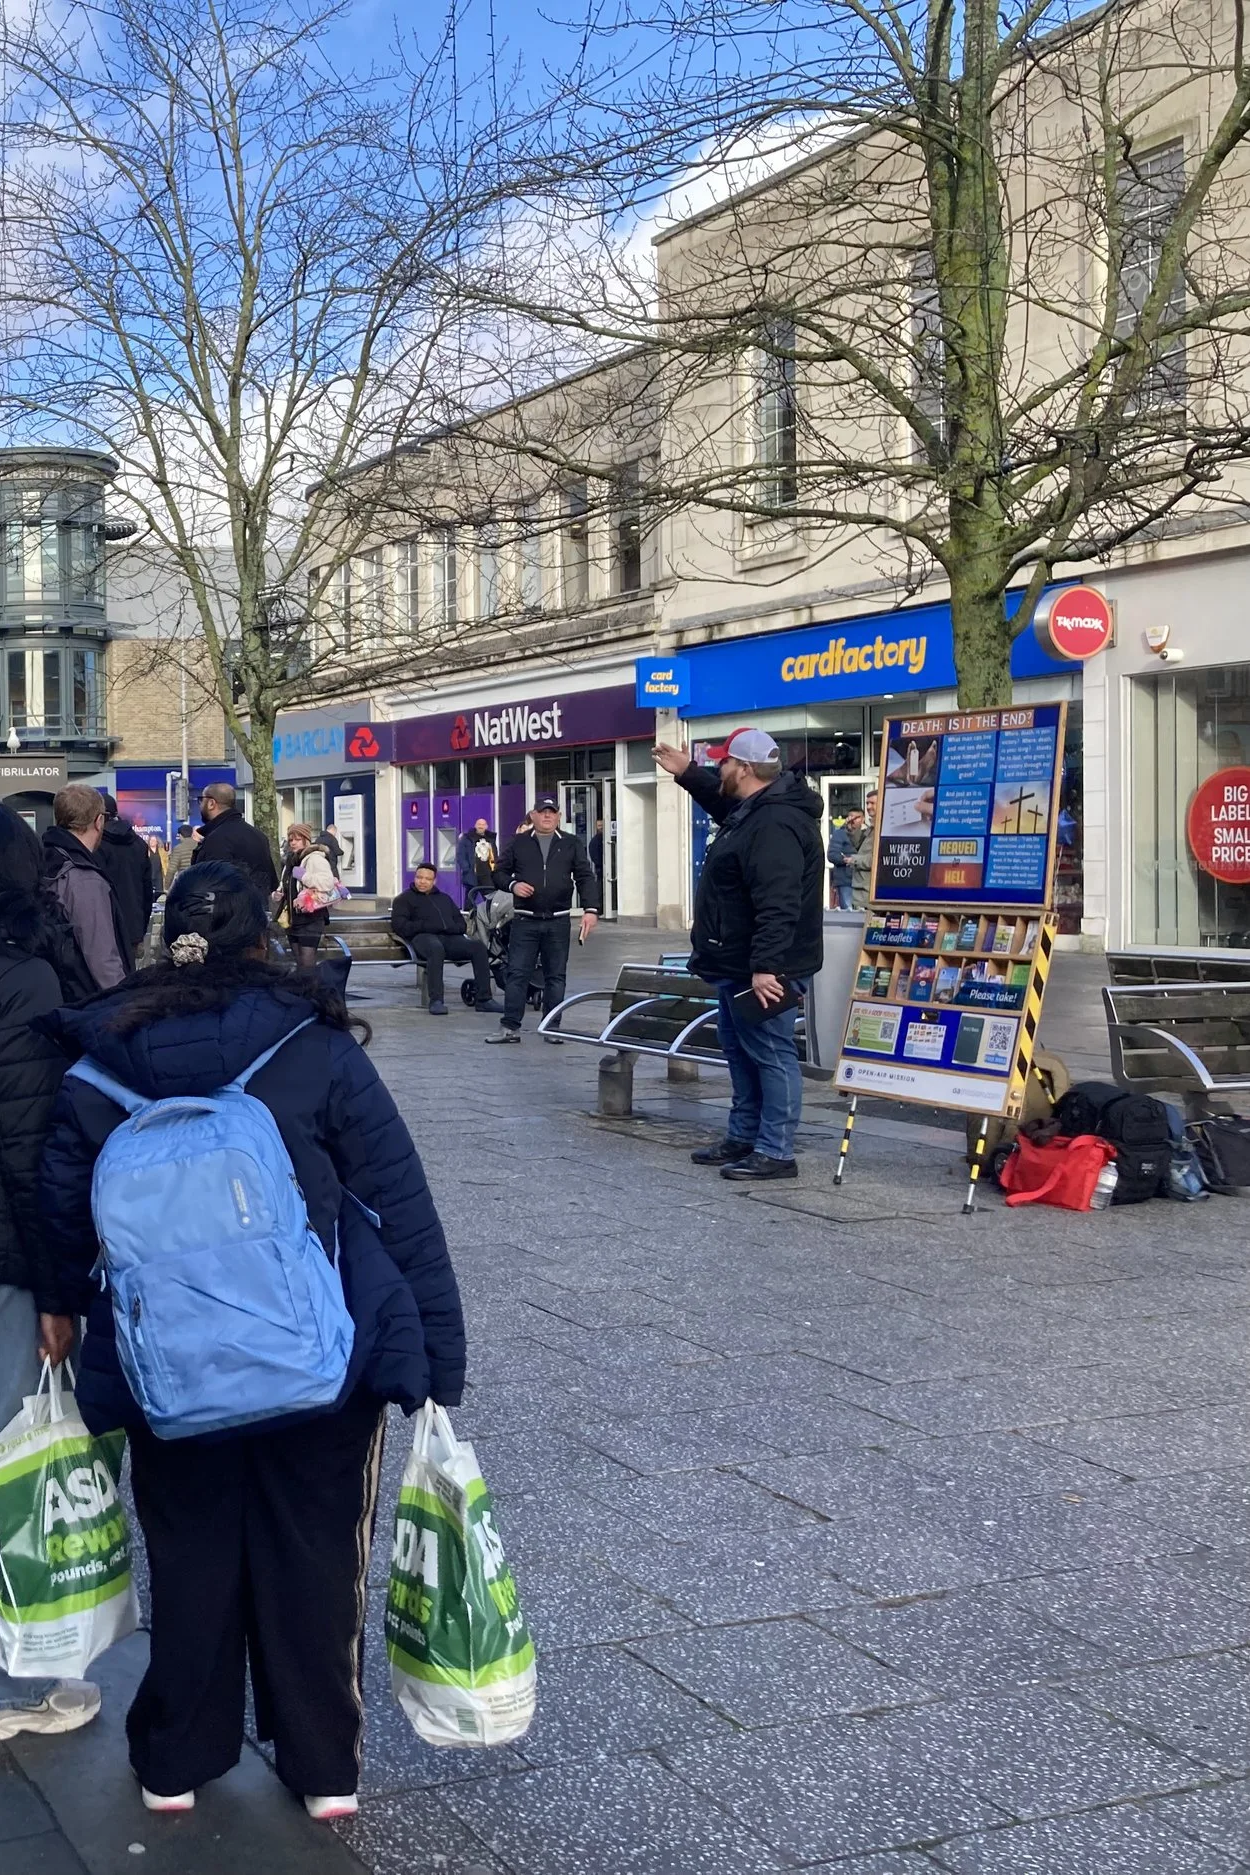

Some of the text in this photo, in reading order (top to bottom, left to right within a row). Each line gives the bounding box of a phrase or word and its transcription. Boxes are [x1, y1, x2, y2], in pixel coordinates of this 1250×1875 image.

[781, 635, 927, 682] cardfactory
[651, 668, 673, 680] card
[645, 681, 679, 695] factory
[474, 701, 562, 747] NatWest
[902, 711, 1033, 734] DEATH: IS IT THE END?
[1224, 785, 1248, 802] BIG
[889, 843, 921, 854] WHERE
[939, 841, 977, 855] HEAVEN
[882, 856, 926, 866] WILL YOU
[893, 868, 913, 878] GO?
[944, 870, 966, 884] HELL
[872, 931, 913, 944] Free leaflets
[970, 988, 1018, 1004] Please take!
[858, 1068, 916, 1083] OPEN-AIR MISSION
[50, 1560, 108, 1588] pounds,
